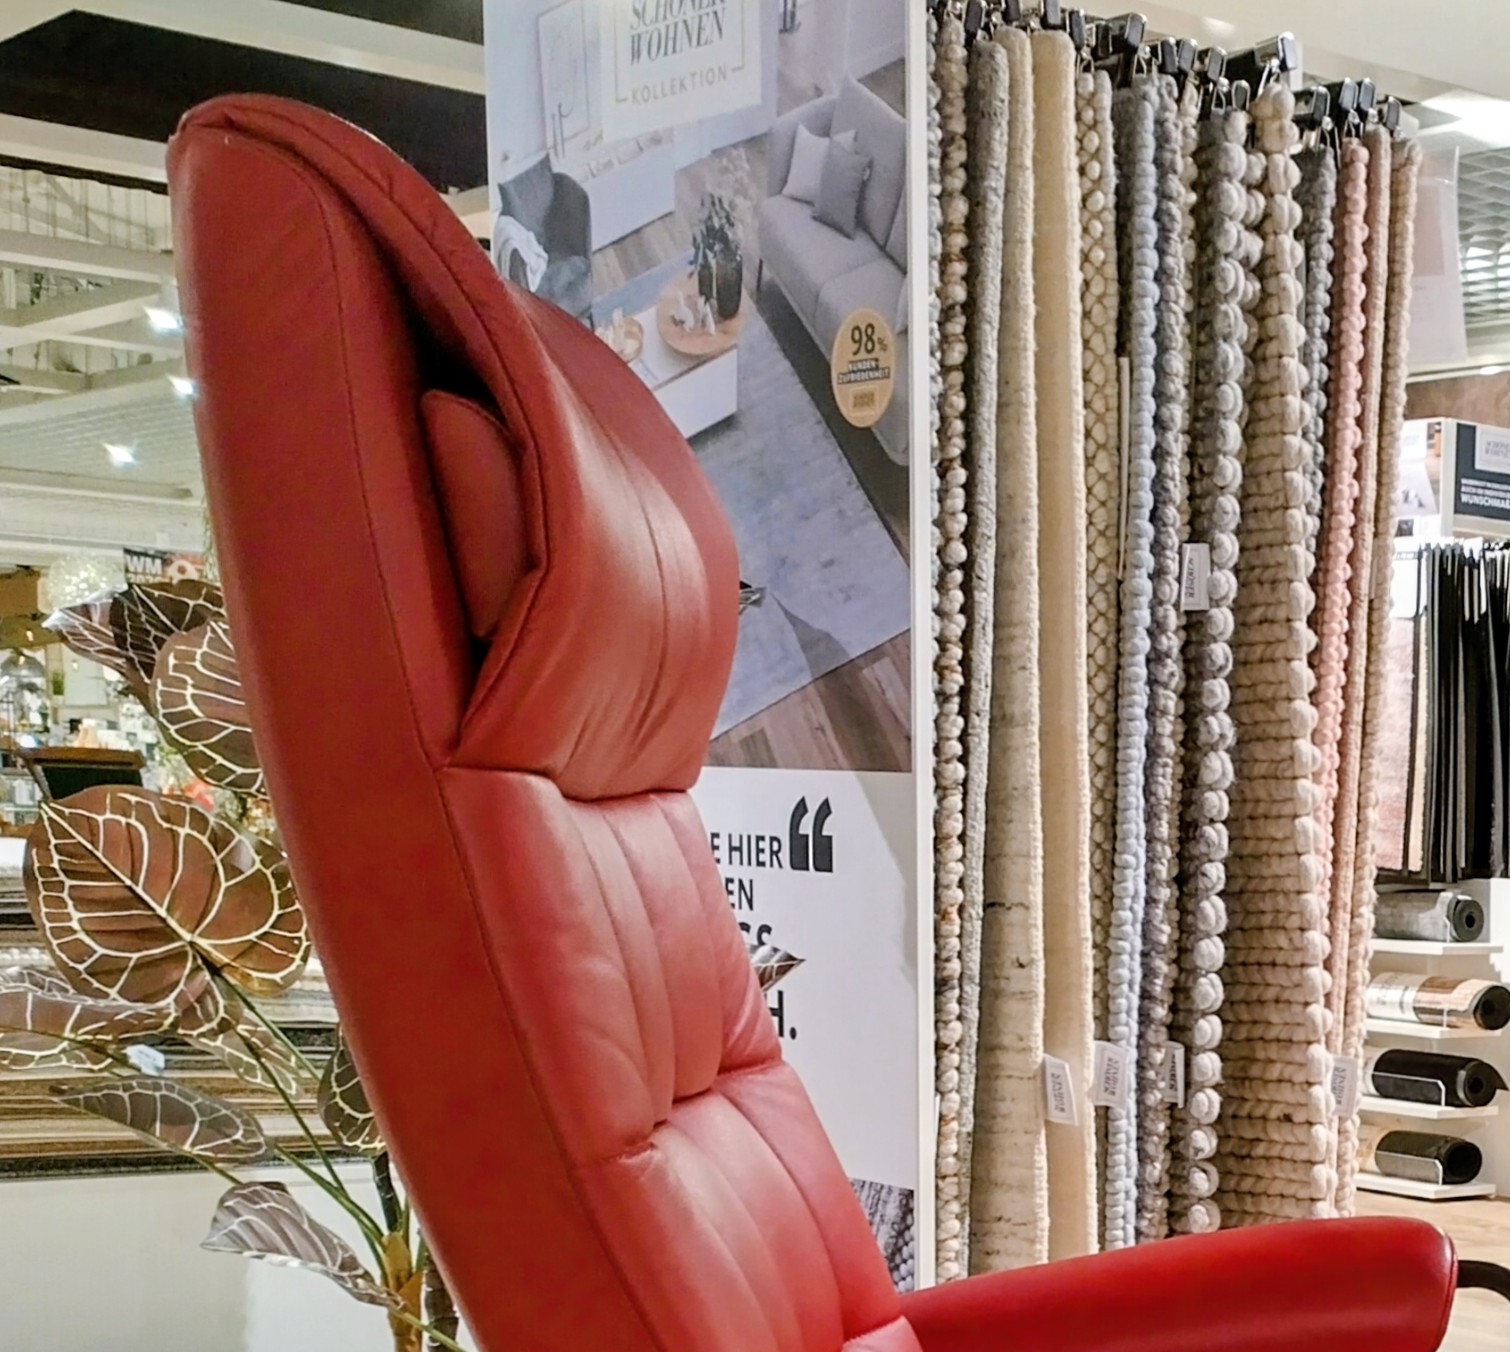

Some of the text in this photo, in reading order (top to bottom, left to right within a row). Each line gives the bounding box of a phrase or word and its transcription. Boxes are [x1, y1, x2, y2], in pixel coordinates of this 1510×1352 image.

[630, 6, 727, 66] WOHNEN
[631, 64, 727, 105] KOLLEKTION
[125, 553, 162, 575] WM
[728, 833, 783, 869] HIER
